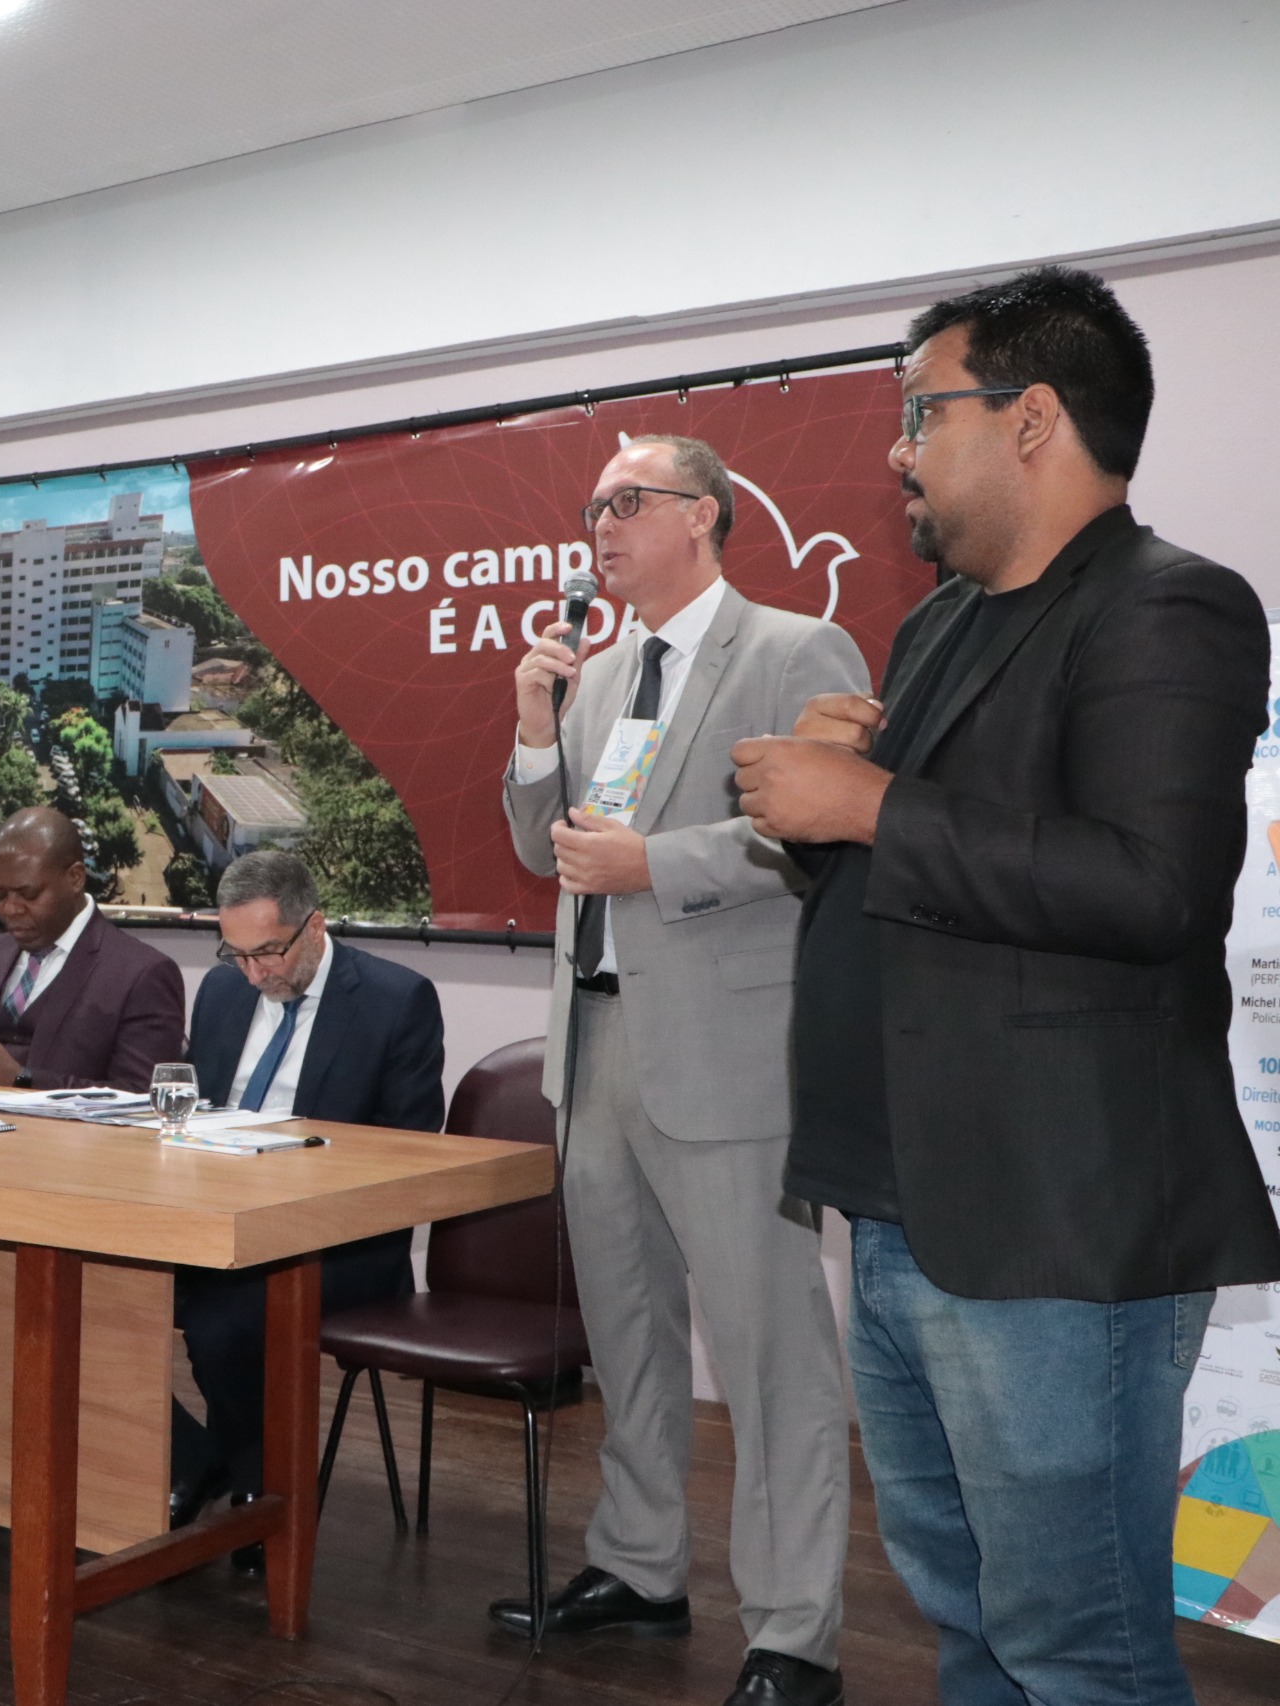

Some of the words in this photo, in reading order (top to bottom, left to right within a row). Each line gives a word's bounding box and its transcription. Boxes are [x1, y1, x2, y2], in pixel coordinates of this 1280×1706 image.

[279, 555, 430, 602] Nosso
[443, 541, 601, 595] camp
[430, 598, 456, 654] É
[470, 605, 507, 651] A
[1252, 958, 1280, 969] Marti
[1251, 973, 1280, 987] (PERF
[1241, 996, 1276, 1008] Michel
[1252, 1011, 1280, 1024] Políci
[1258, 1057, 1280, 1074] 10
